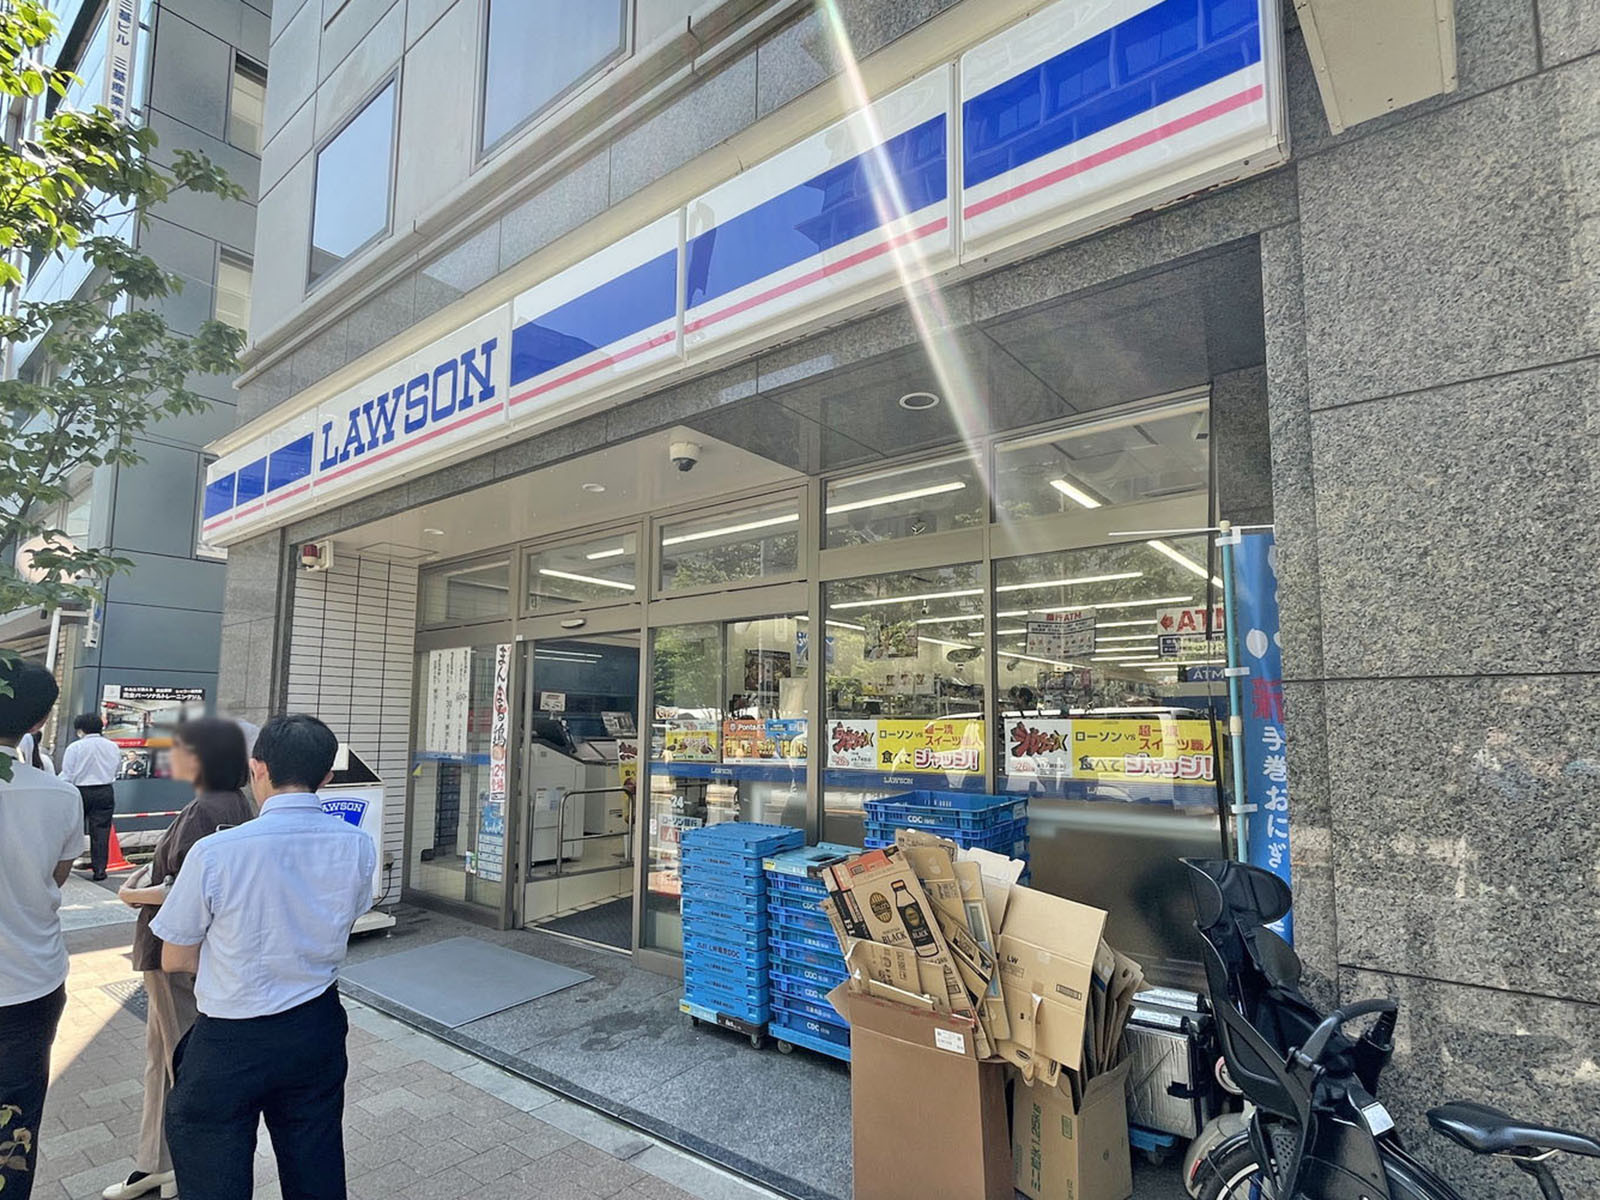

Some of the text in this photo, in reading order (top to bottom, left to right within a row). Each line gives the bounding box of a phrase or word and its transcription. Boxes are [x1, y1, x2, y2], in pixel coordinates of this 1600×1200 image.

[320, 337, 498, 471] LAWSON
[1193, 669, 1224, 680] ATM
[879, 730, 914, 739] ローソン
[1075, 731, 1122, 742] ローソン
[1139, 724, 1178, 738] 超一流
[915, 748, 979, 770] ジャッジ!
[1079, 754, 1121, 771] 食べて
[1124, 752, 1214, 780] ジャッジ!
[322, 802, 363, 812] AWSON
[670, 795, 684, 809] 24
[1262, 726, 1288, 874] 手巻おにぎ
[908, 815, 923, 824] CDC
[881, 930, 908, 945] BLACK
[911, 930, 928, 940] BLACK
[1006, 954, 1019, 964] LW
